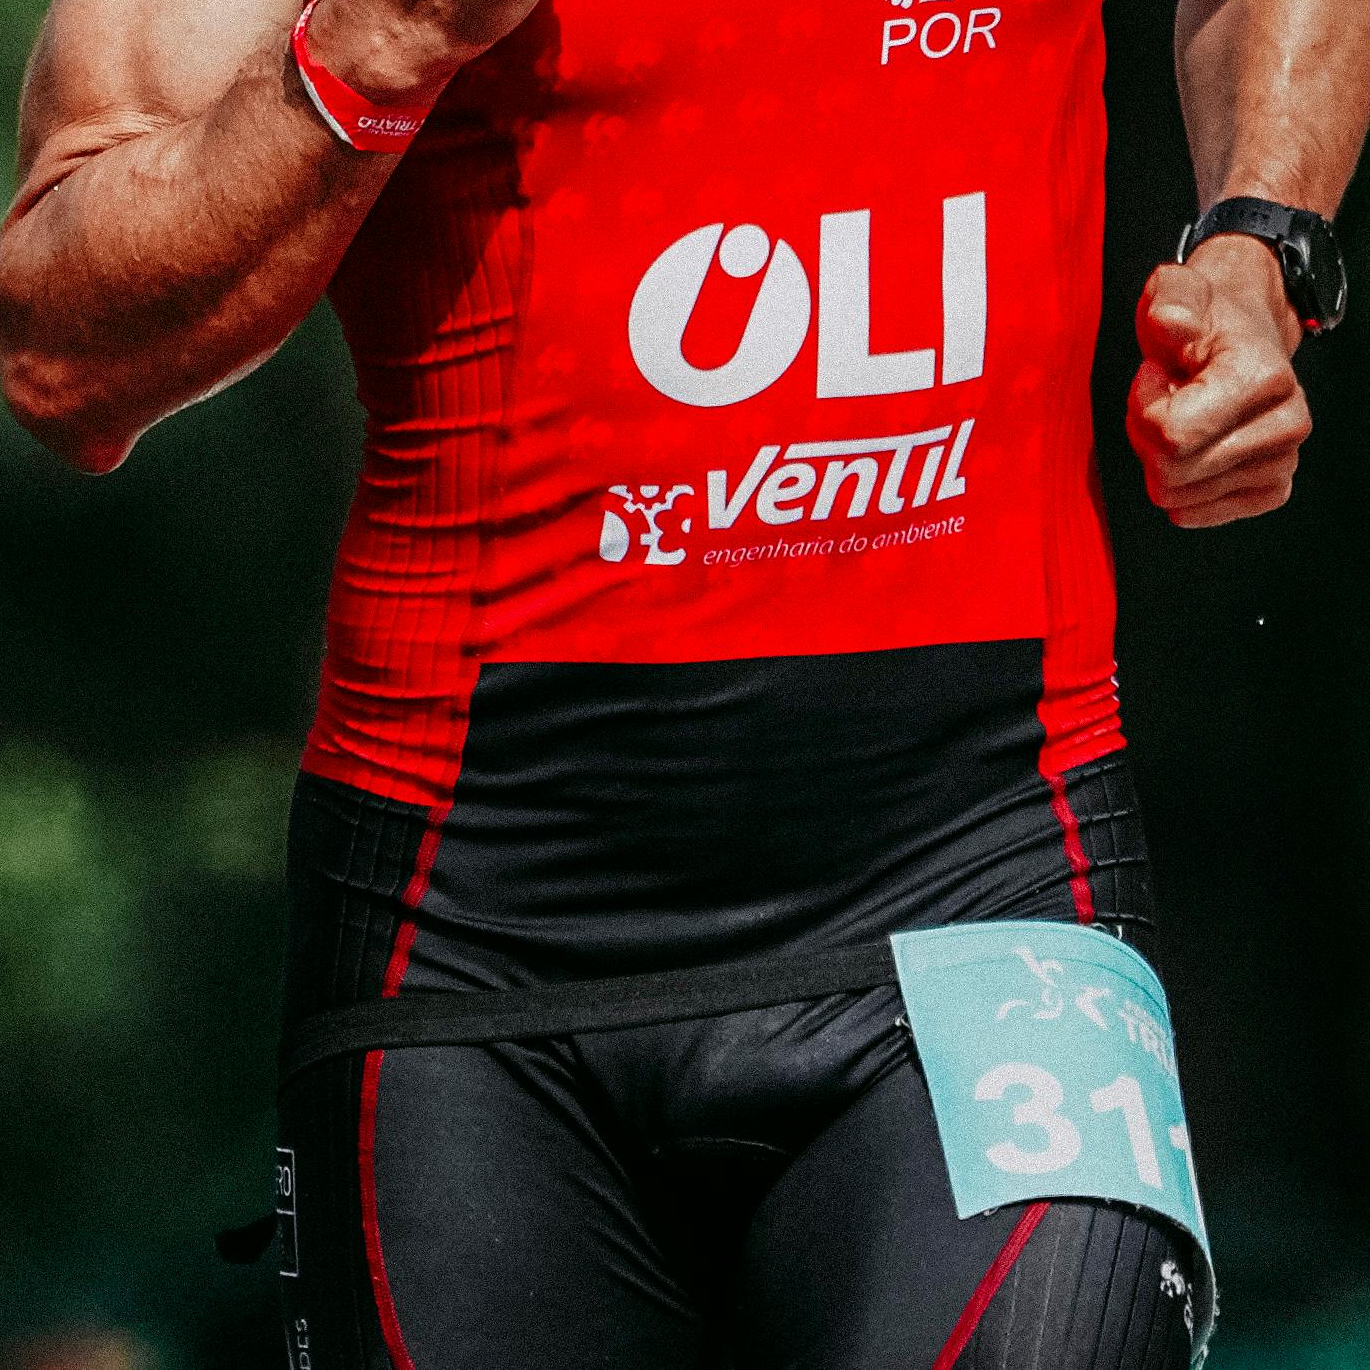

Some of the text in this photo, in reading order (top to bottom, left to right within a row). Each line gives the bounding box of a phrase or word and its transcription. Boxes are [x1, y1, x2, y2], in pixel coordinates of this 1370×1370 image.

[880, 7, 1002, 65] POR
[628, 191, 988, 408] OLI
[703, 515, 965, 568] engenharia do ambiente
